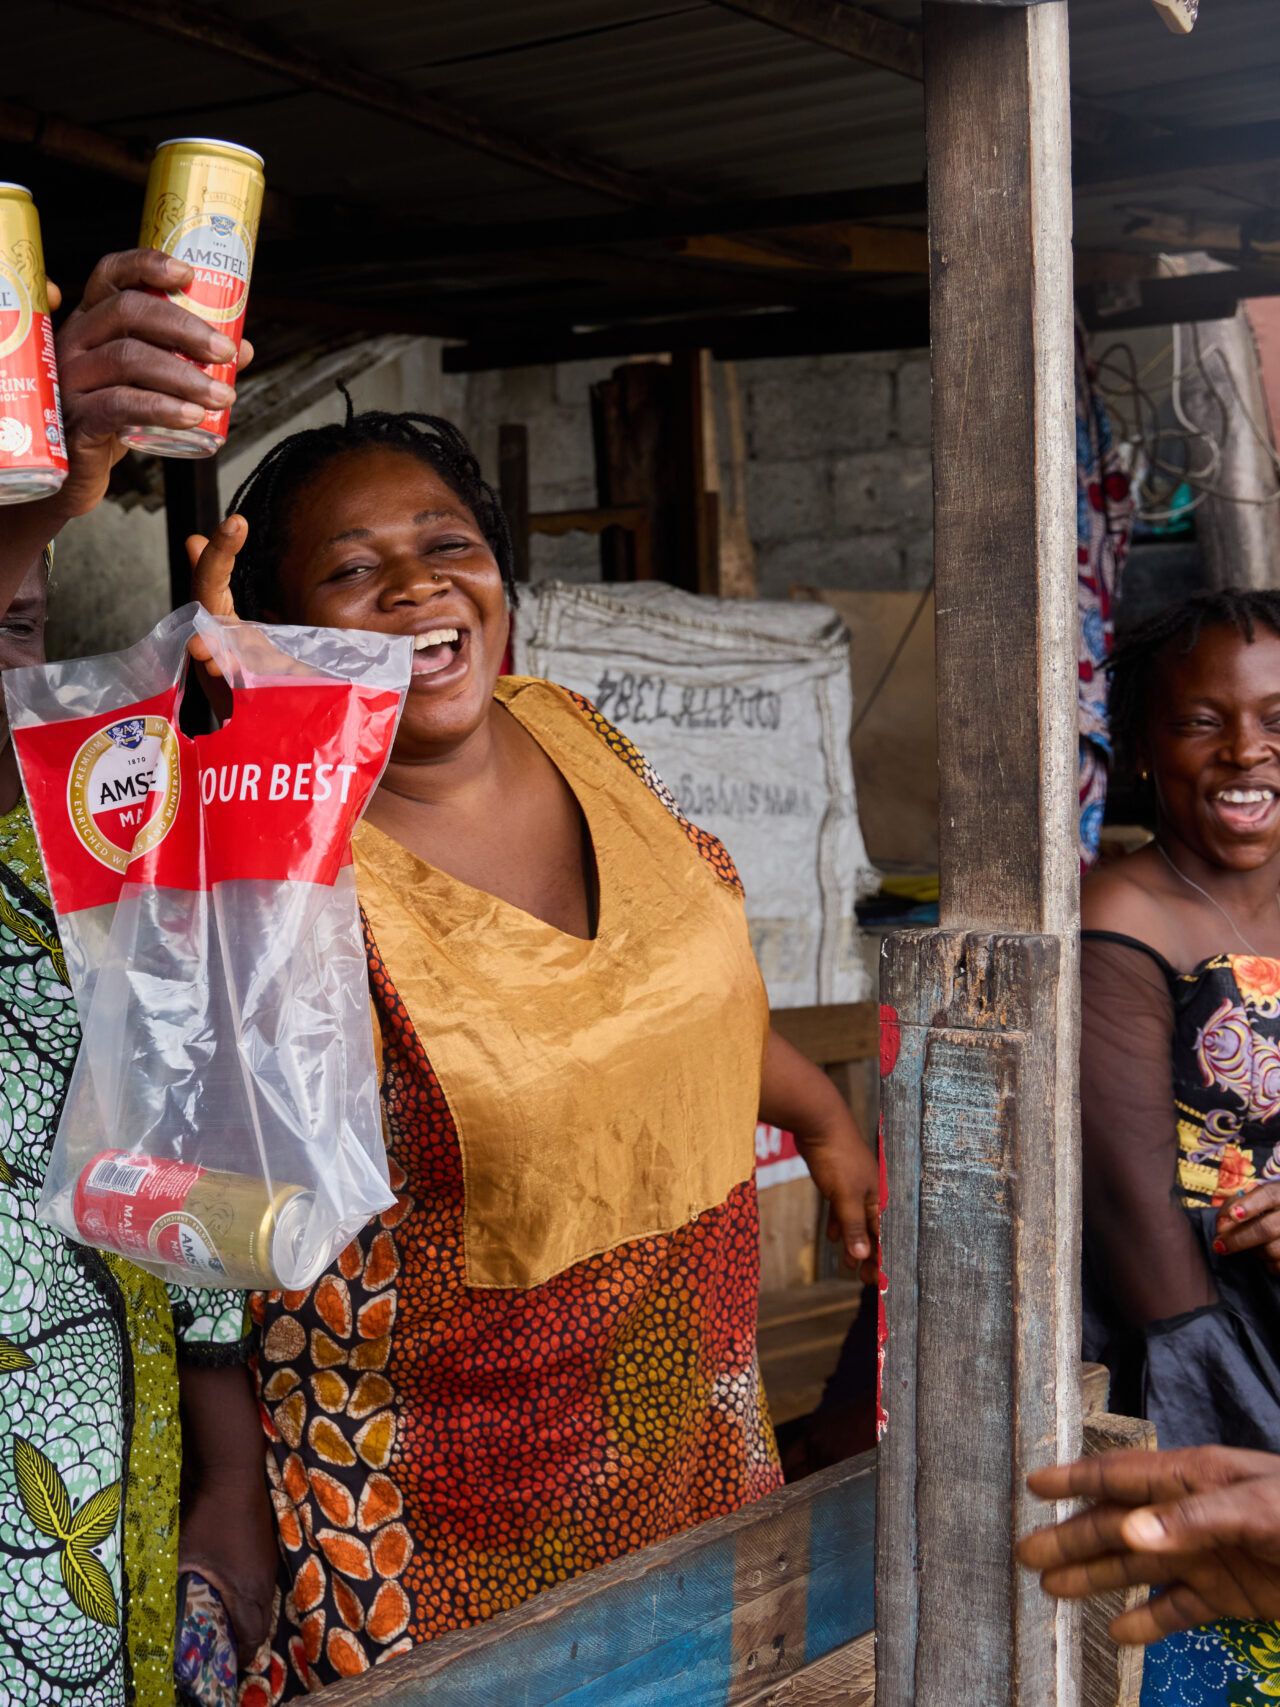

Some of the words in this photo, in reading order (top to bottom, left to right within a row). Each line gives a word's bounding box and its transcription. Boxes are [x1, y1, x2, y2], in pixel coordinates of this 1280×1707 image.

[182, 248, 244, 277] AMSTEL
[194, 269, 234, 291] MALTA
[75, 740, 104, 788] PREMIUM
[128, 756, 146, 766] 1870
[147, 820, 167, 842] AND
[166, 753, 178, 818] MINERALS
[199, 764, 261, 806] OUR
[269, 763, 357, 804] BEST
[74, 800, 108, 856] ENRICHED
[123, 1204, 134, 1242] MALT
